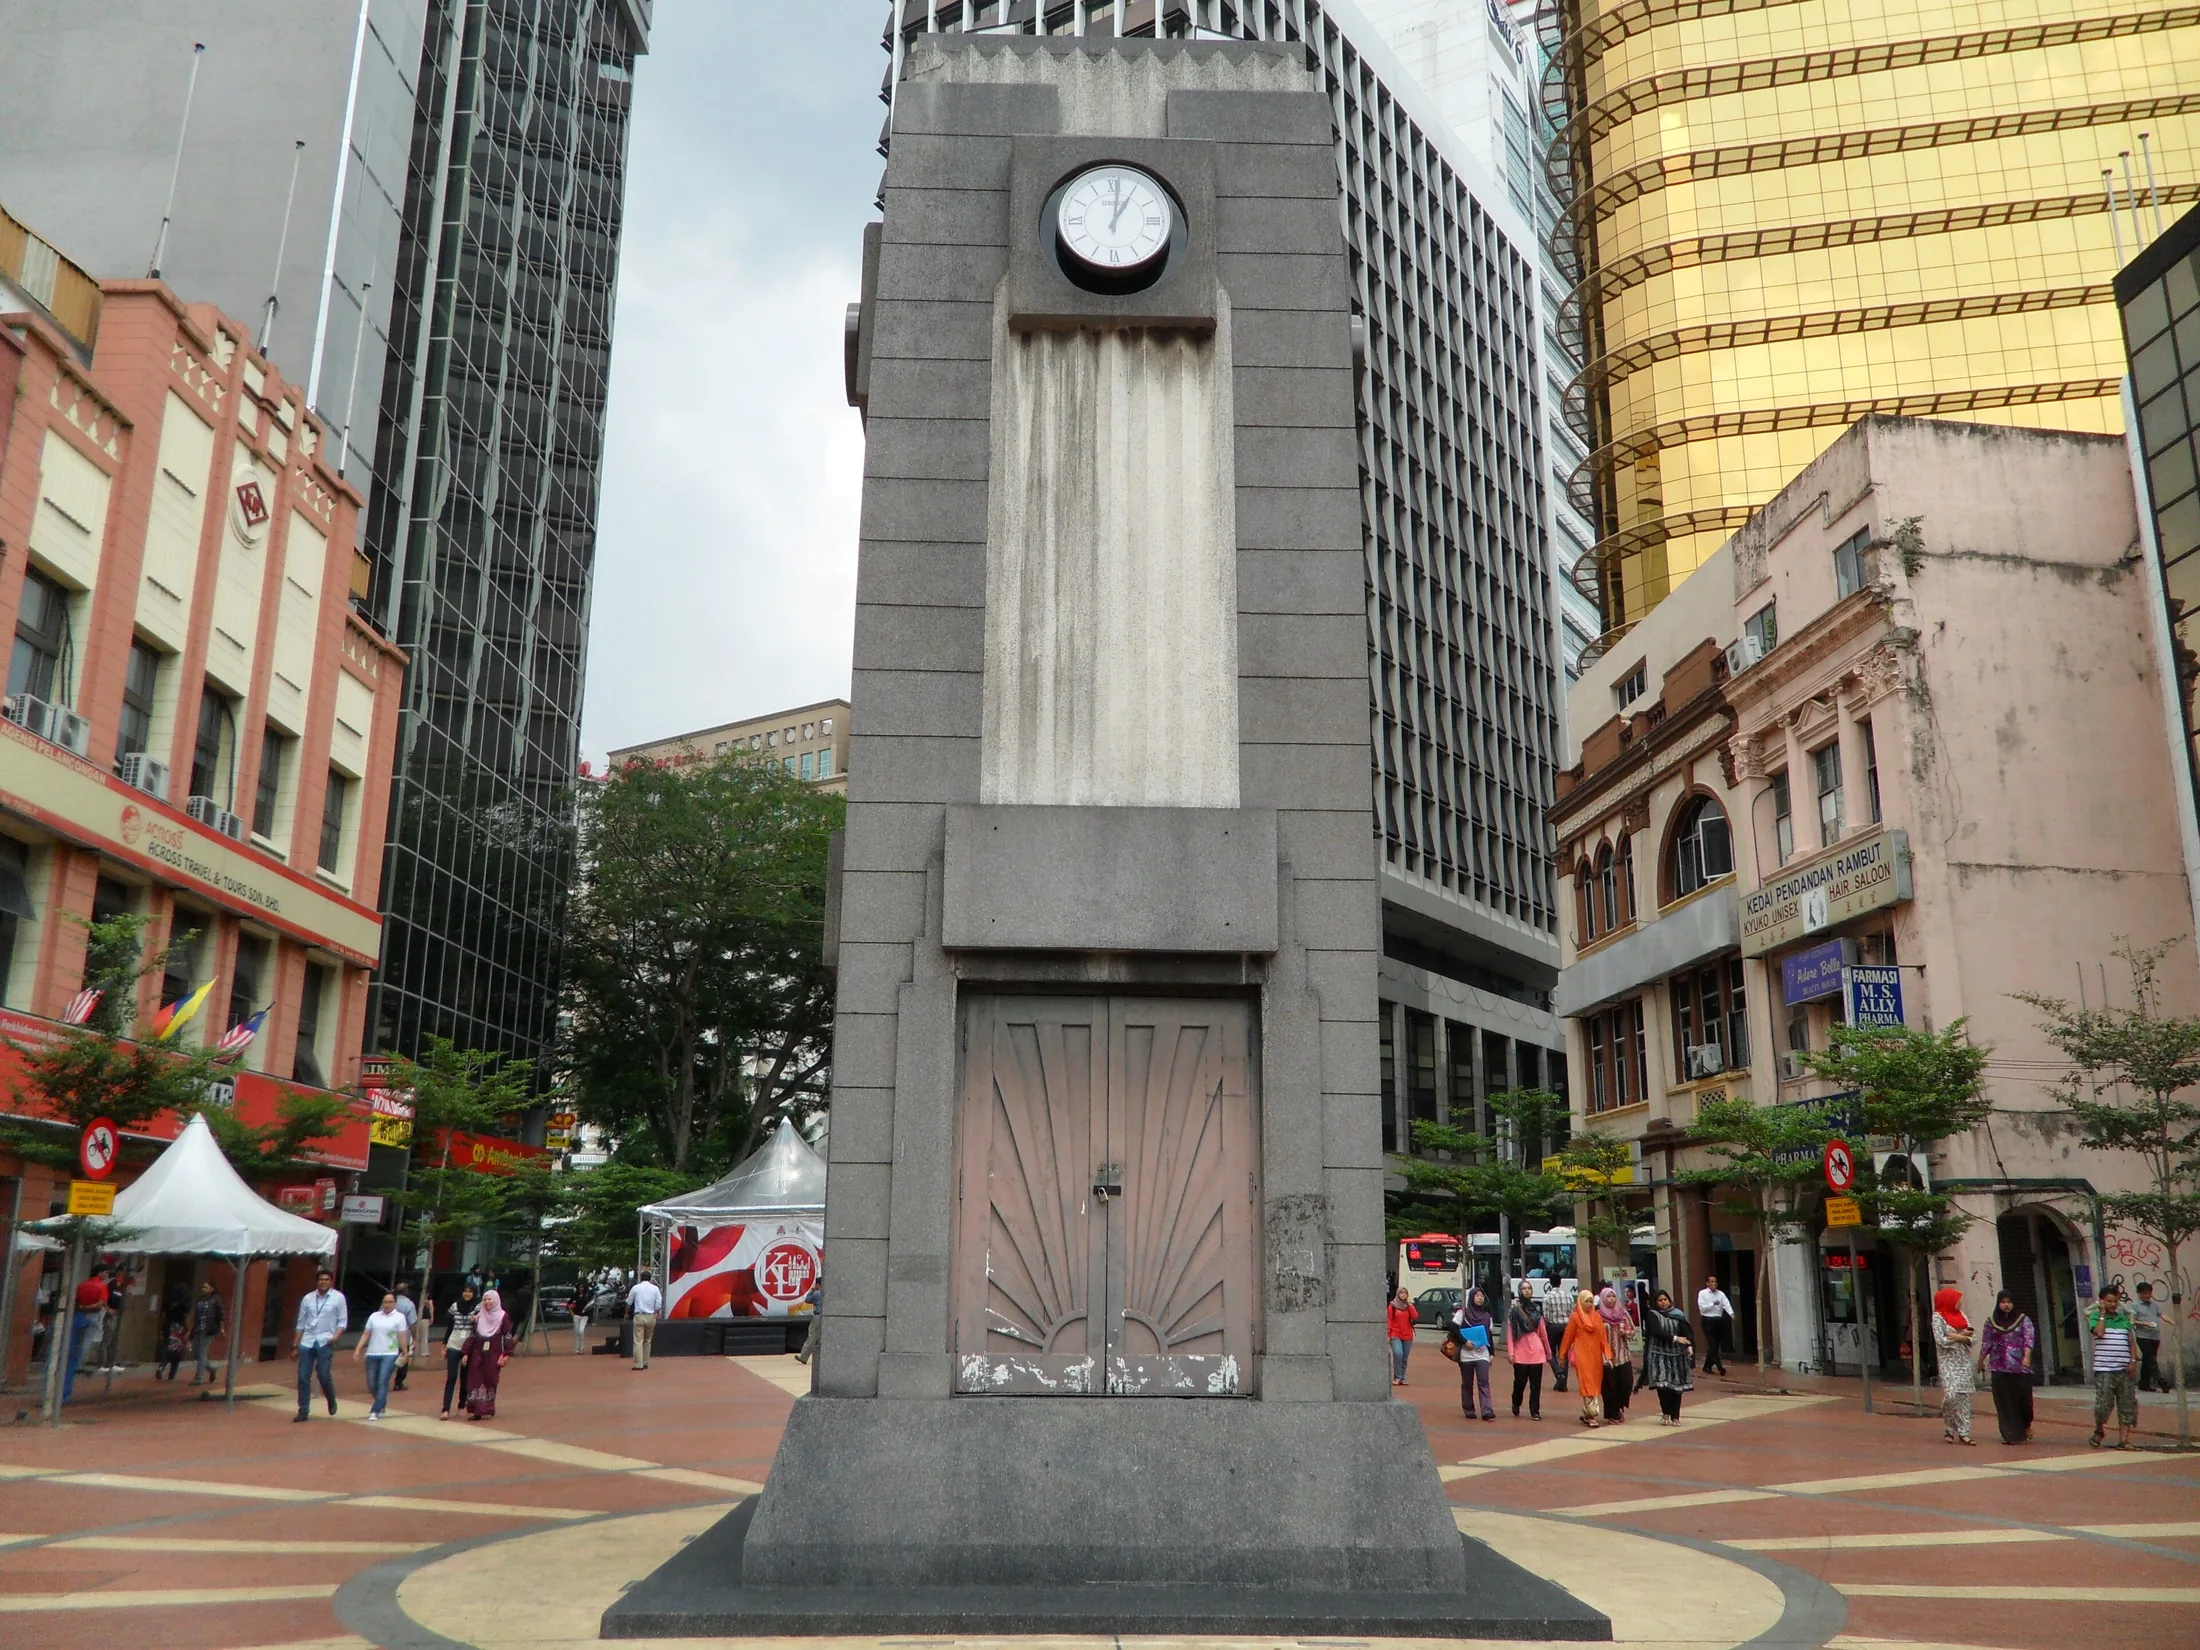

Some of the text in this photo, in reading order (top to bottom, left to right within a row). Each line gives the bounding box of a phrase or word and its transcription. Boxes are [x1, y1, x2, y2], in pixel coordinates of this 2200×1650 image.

[1, 722, 37, 751] AGENSI
[145, 821, 185, 850] ACROSS
[148, 842, 182, 868] ACROSS
[184, 856, 211, 883] TRAVEL
[224, 876, 247, 897] TOURS
[1747, 842, 1881, 916] KEDAI PENDANDAN RAMBUT
[1829, 861, 1891, 901] HAIR SALOON
[1744, 900, 1799, 935] KYUKO UNISEX
[1819, 957, 1841, 977] Belle
[1853, 969, 1898, 984] FARMASI
[1861, 984, 1894, 998] M. S.
[1860, 998, 1896, 1013] ALLY
[1859, 1012, 1900, 1025] PHARMA
[1775, 1148, 1816, 1166] PHARMA
